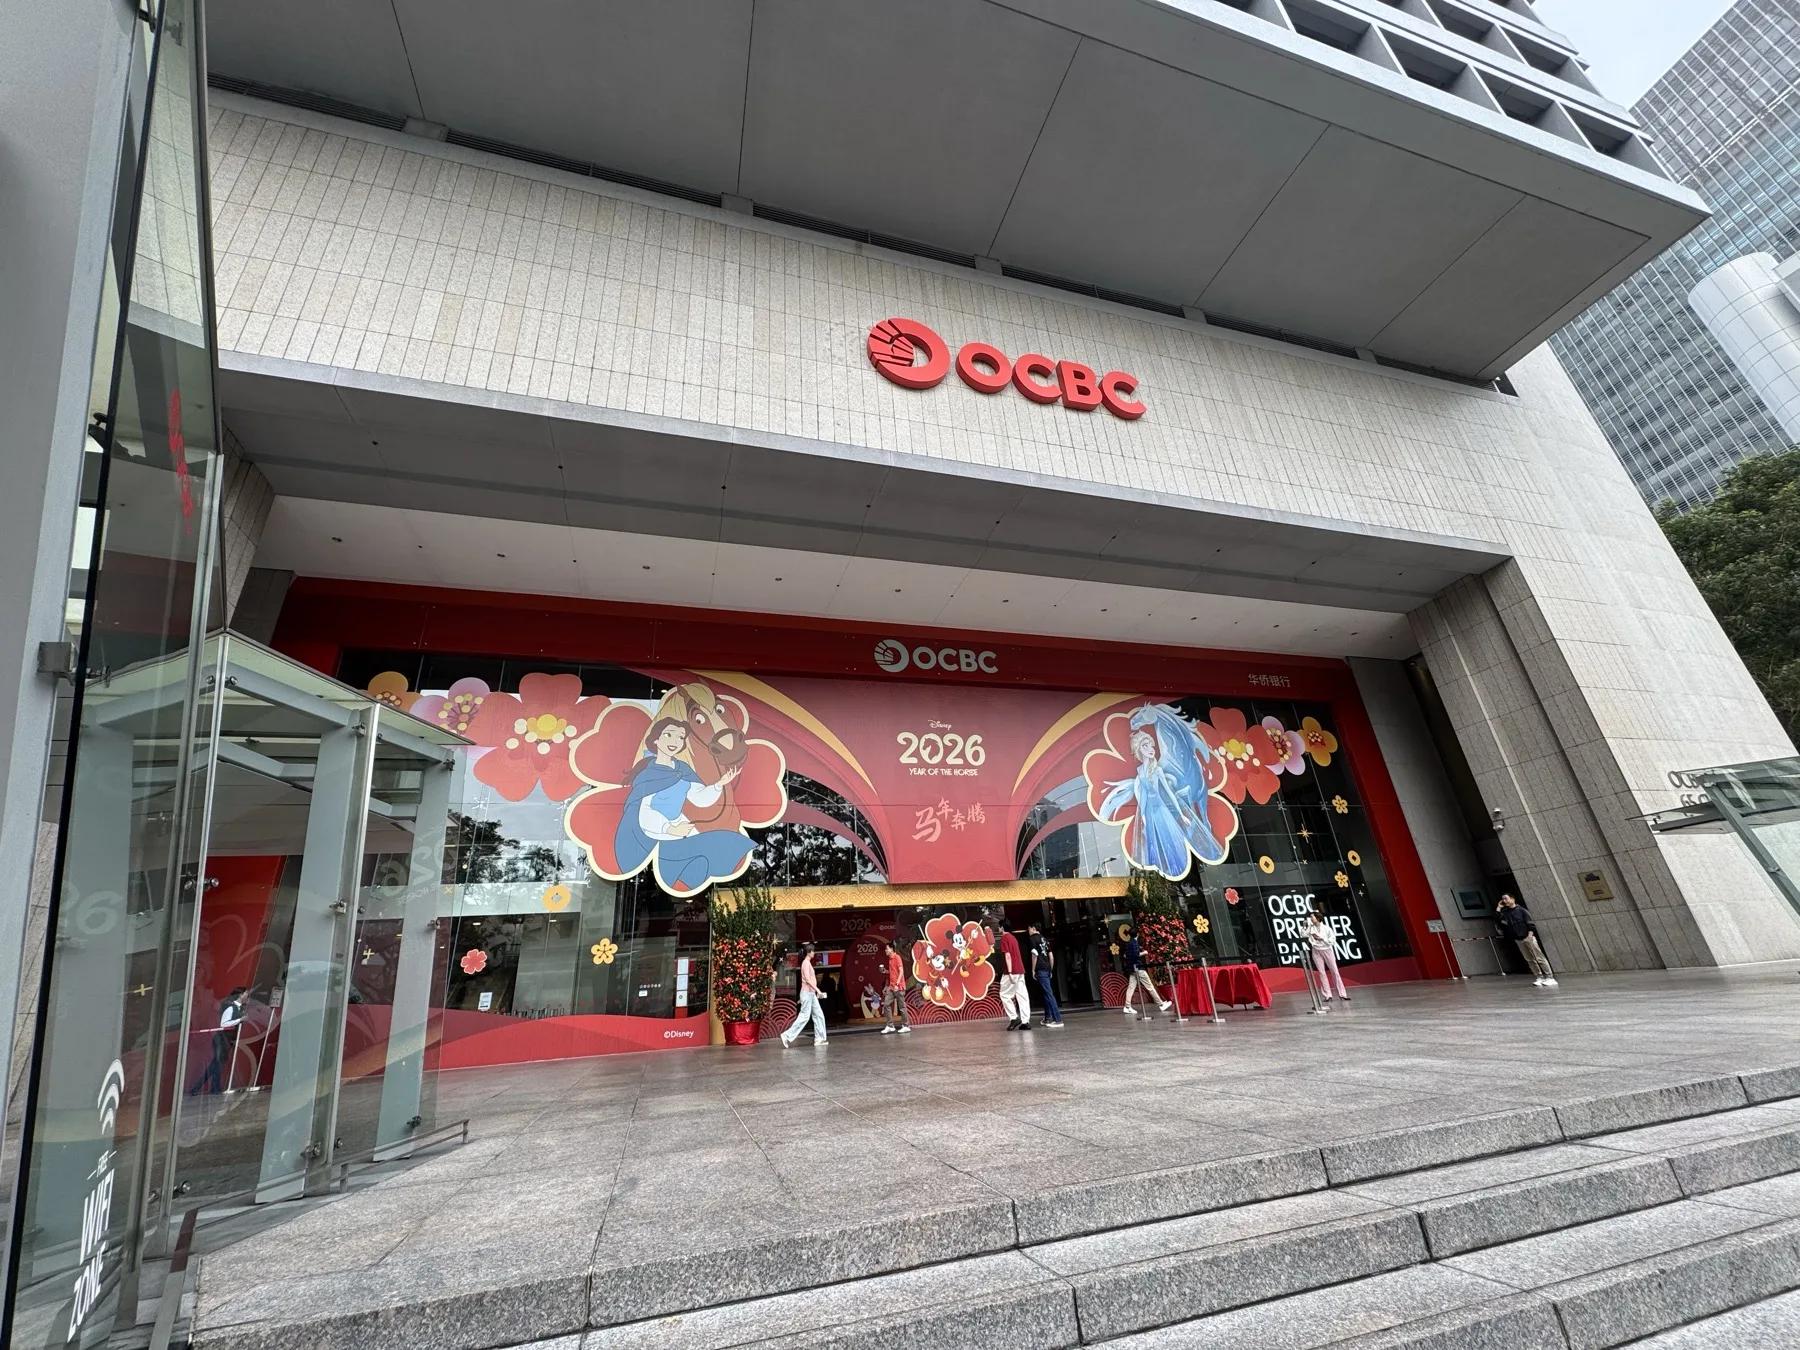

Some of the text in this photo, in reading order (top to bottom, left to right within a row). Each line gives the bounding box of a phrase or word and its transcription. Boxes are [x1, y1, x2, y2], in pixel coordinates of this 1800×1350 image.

[955, 342, 1147, 420] OCBC
[912, 646, 999, 674] OCBC
[1248, 673, 1290, 687] 华侨银行
[927, 719, 952, 731] Disney
[896, 731, 986, 766] 2026
[909, 767, 979, 777] YEAR OF THE HORSE
[1667, 770, 1700, 789] OCB
[1267, 894, 1320, 916] OCBC
[79, 1168, 115, 1265] WIFI
[66, 1241, 108, 1343] ZONE
